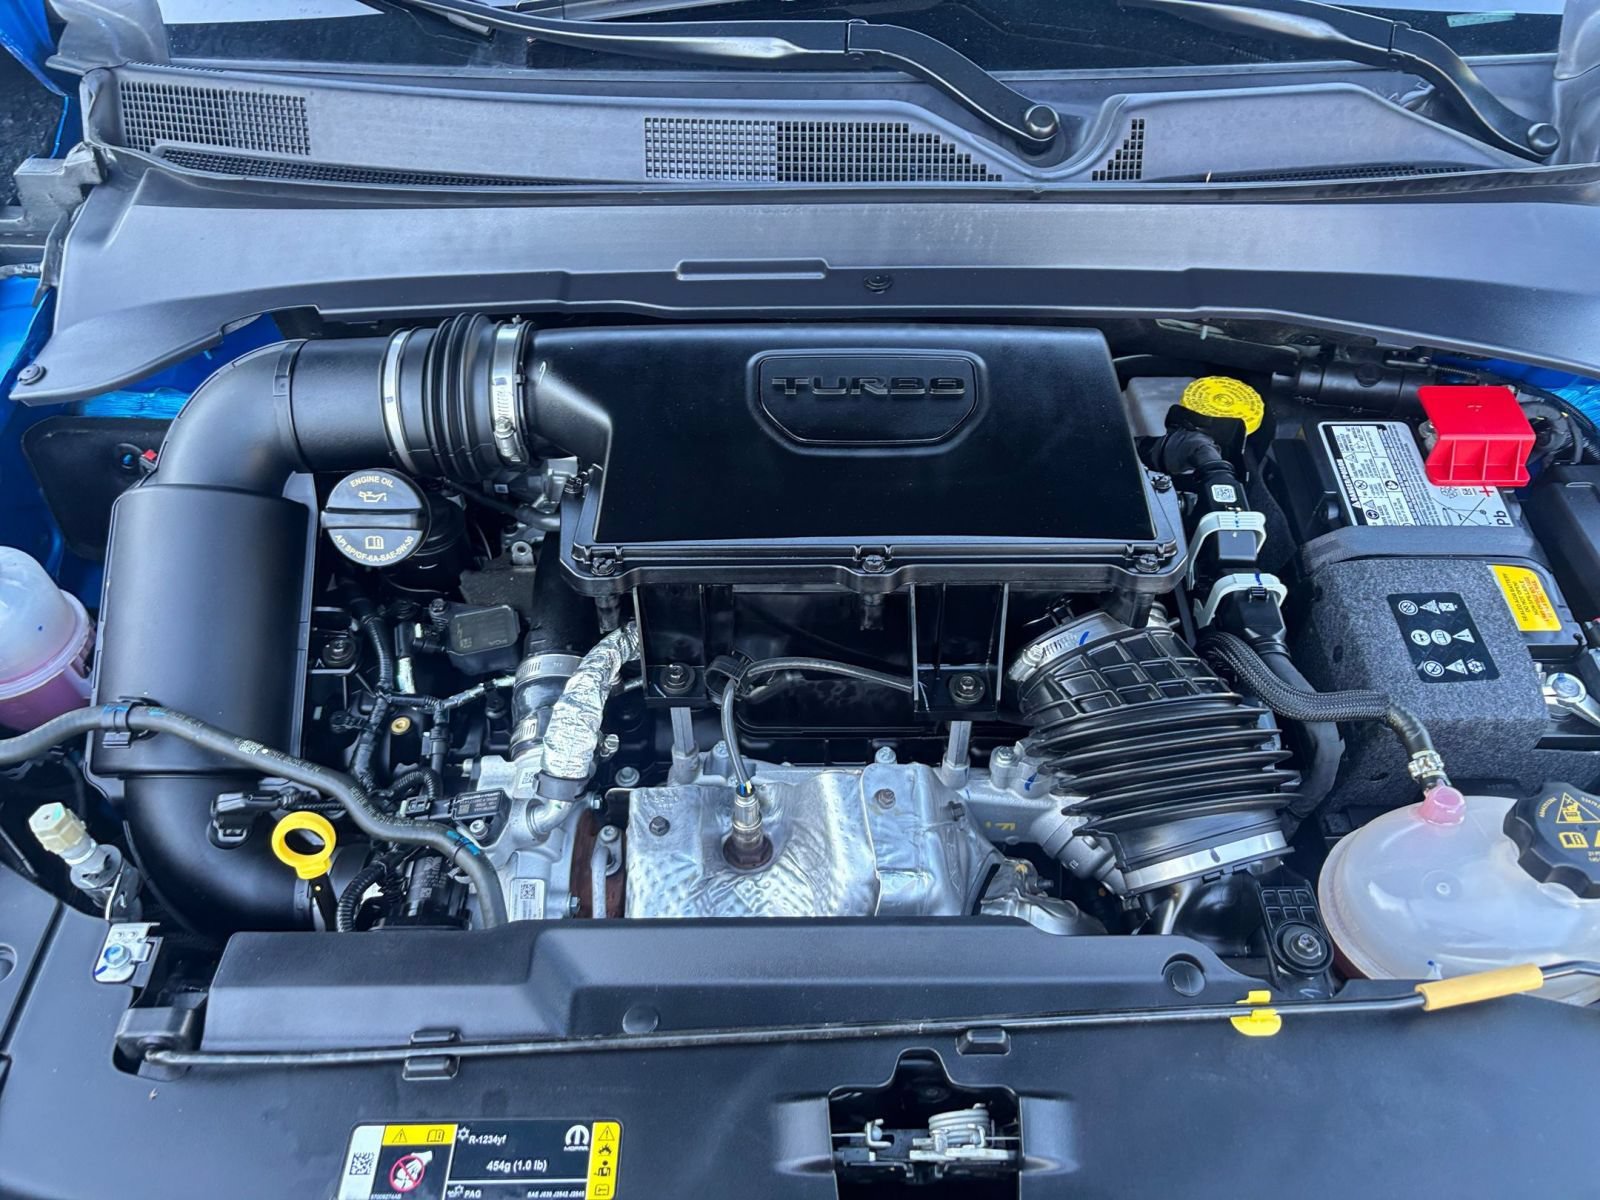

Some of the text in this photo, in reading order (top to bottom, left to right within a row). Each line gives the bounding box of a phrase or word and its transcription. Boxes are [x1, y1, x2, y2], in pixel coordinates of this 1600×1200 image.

[772, 376, 966, 395] TURBO
[350, 475, 395, 489] ENGINE OIL
[1493, 510, 1511, 526] Pb
[335, 534, 347, 547] API
[468, 1134, 507, 1146] R-1234yf
[486, 1159, 548, 1174] 454g (1.0 lb)
[464, 1190, 482, 1199] PAG
